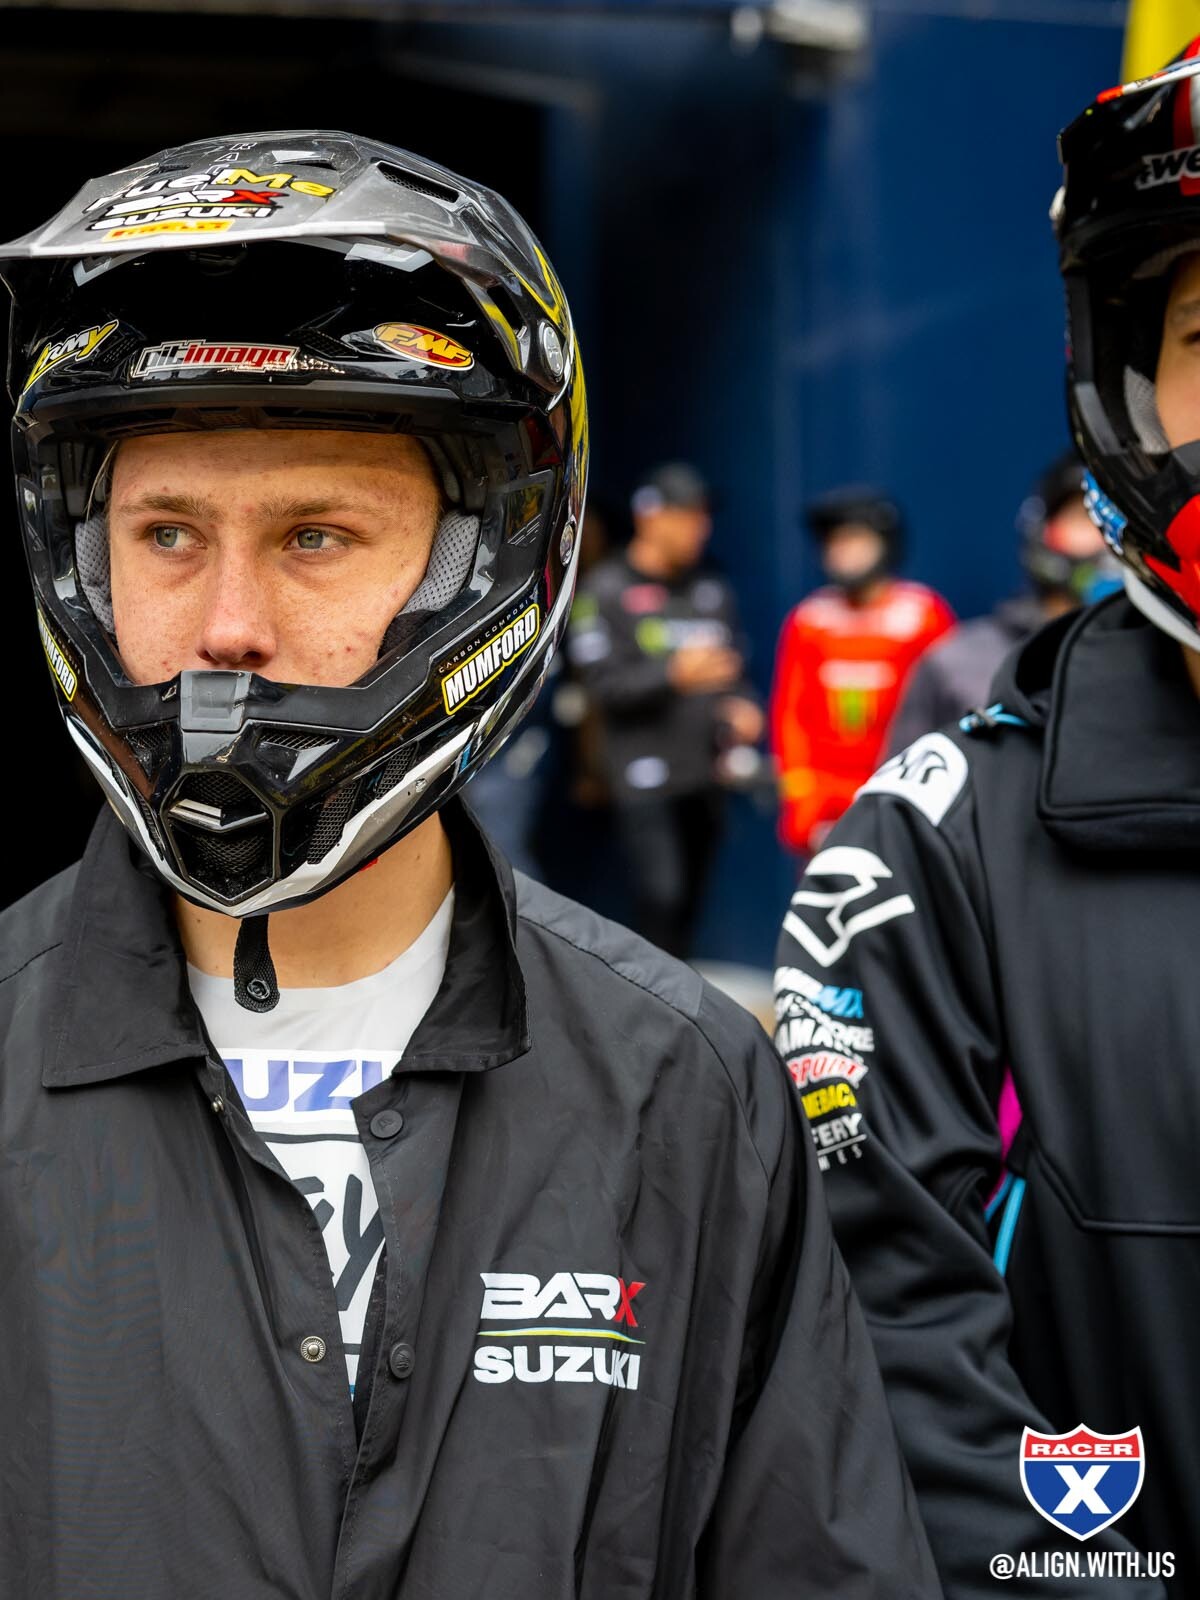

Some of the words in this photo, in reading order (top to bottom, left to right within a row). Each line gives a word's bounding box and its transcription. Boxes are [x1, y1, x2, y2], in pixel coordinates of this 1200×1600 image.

[91, 206, 272, 231] SUZUKI
[377, 326, 472, 361] FMF
[445, 607, 536, 709] MUMFORD
[480, 1272, 647, 1328] BARX
[473, 1345, 641, 1391] SUZUKI
